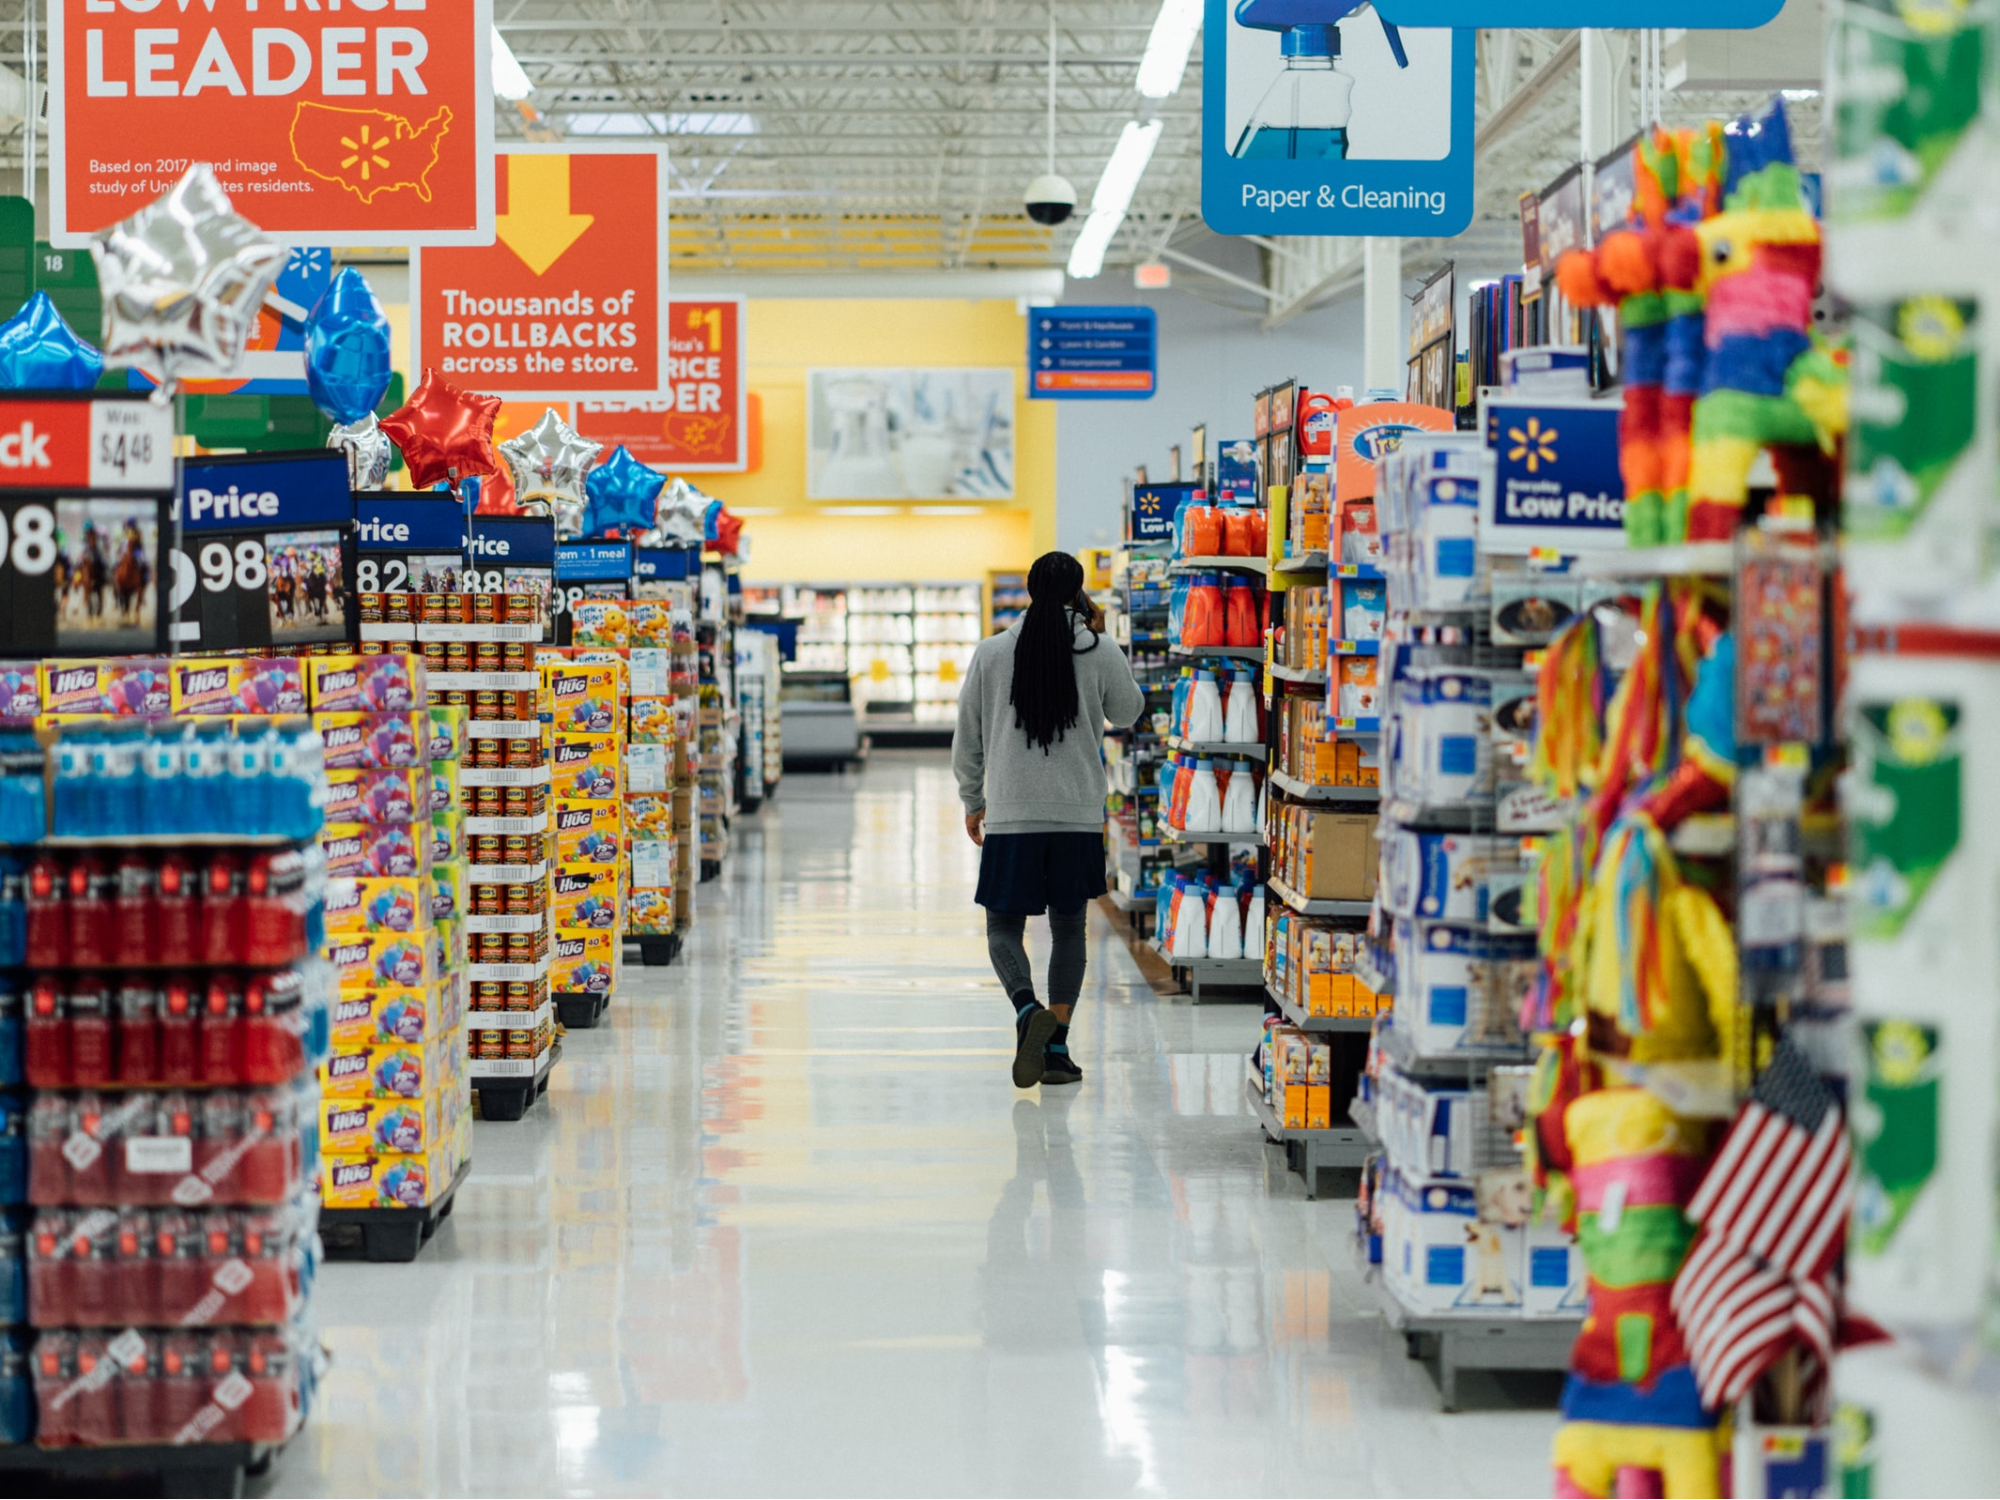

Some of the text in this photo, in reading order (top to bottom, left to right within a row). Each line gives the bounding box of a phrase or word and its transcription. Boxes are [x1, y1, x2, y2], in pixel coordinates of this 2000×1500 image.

[86, 27, 429, 97] LEADER
[89, 159, 130, 173] Based
[140, 162, 151, 173] on
[156, 159, 188, 173] 2017
[236, 159, 277, 175] image
[89, 180, 127, 196] study
[131, 180, 147, 193] of
[248, 180, 314, 192] residents.
[1242, 184, 1446, 215] Paper & Cleaning
[44, 255, 63, 272] 18
[441, 289, 635, 316] Thousands of
[443, 322, 637, 348] ROLLBACKS
[442, 351, 639, 373] across the store.
[189, 485, 280, 520] Price
[1506, 493, 1565, 518] Low
[1141, 523, 1165, 533] Low
[598, 547, 626, 559] meal
[357, 560, 408, 593] 82
[463, 570, 503, 593] 88
